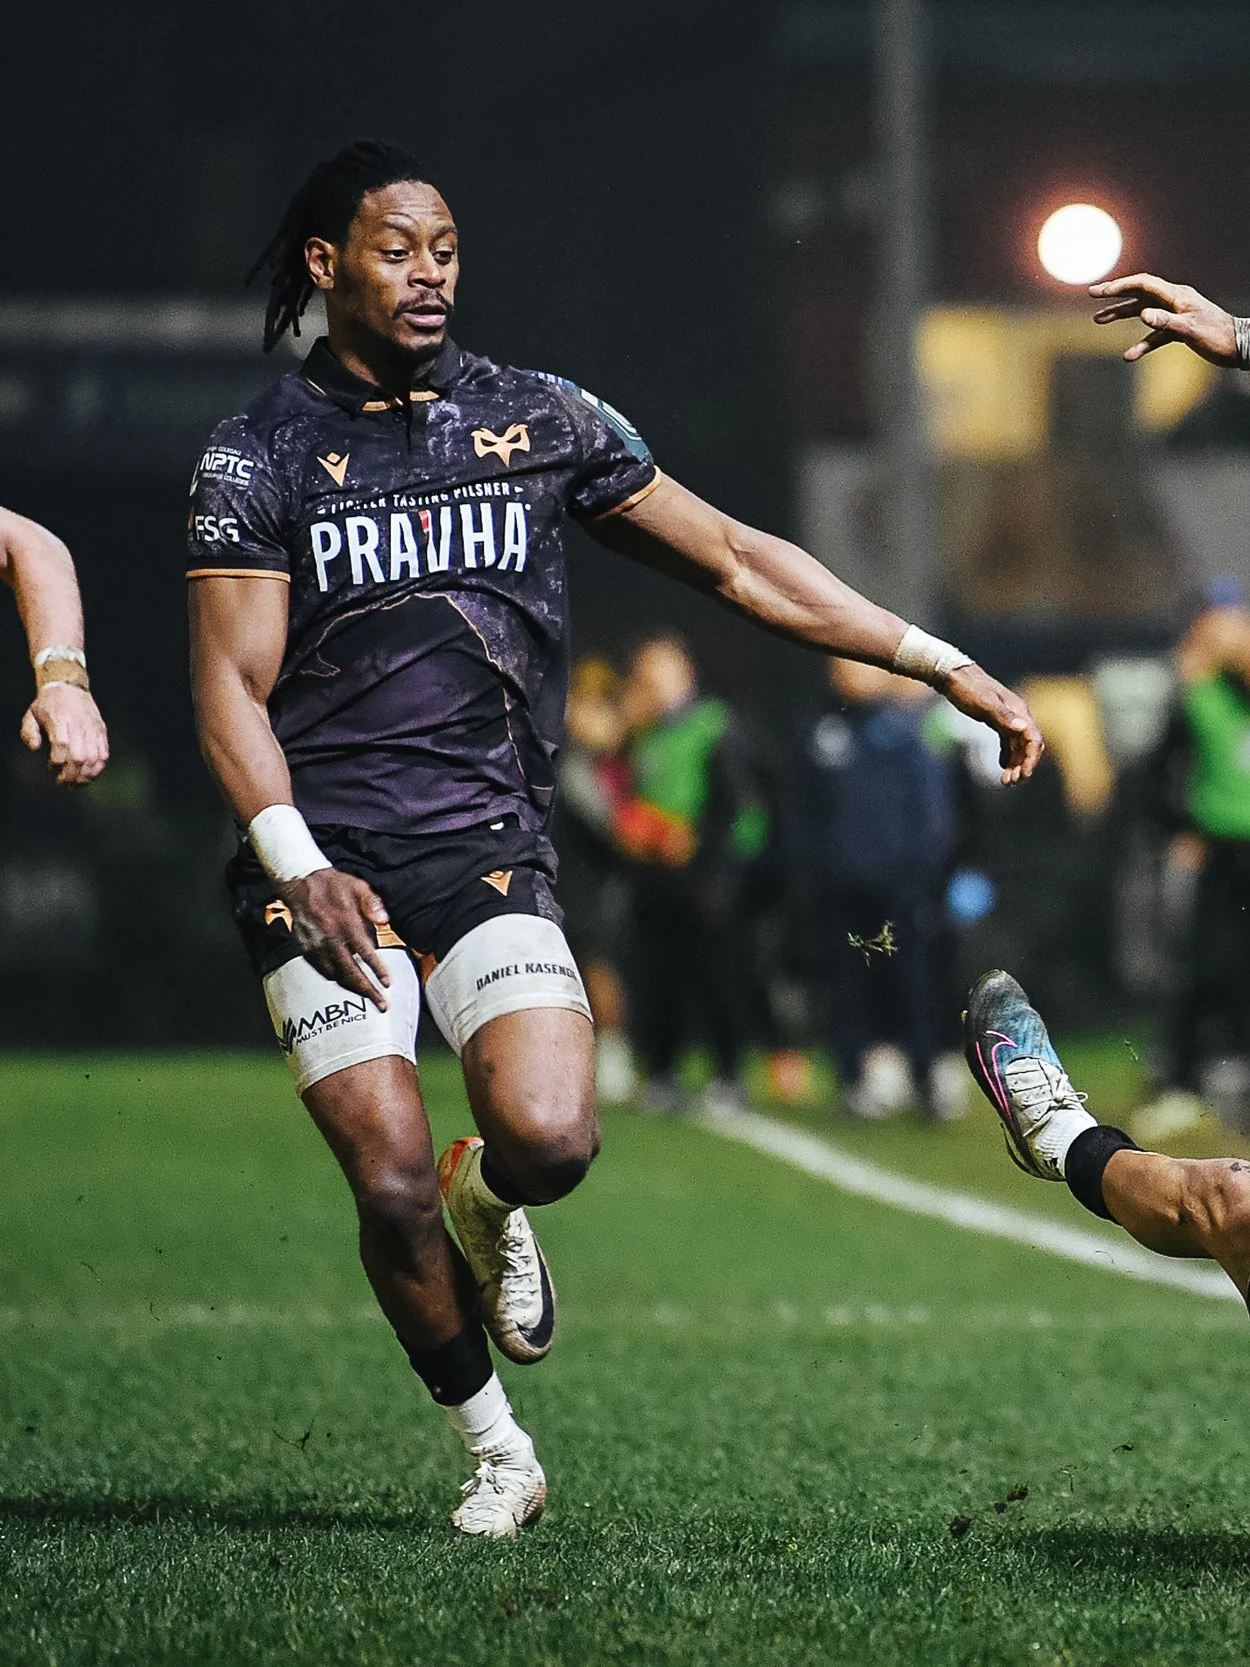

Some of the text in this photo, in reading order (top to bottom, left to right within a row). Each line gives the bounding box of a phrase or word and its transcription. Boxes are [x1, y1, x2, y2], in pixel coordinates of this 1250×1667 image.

[200, 452, 254, 479] NPTC
[453, 482, 510, 499] PILSNER
[194, 515, 240, 543] FSG
[310, 501, 528, 593] PRAVHA
[476, 964, 520, 992] DANIEL
[296, 1013, 367, 1045] MUST BE NICE
[298, 997, 366, 1037] MBN
